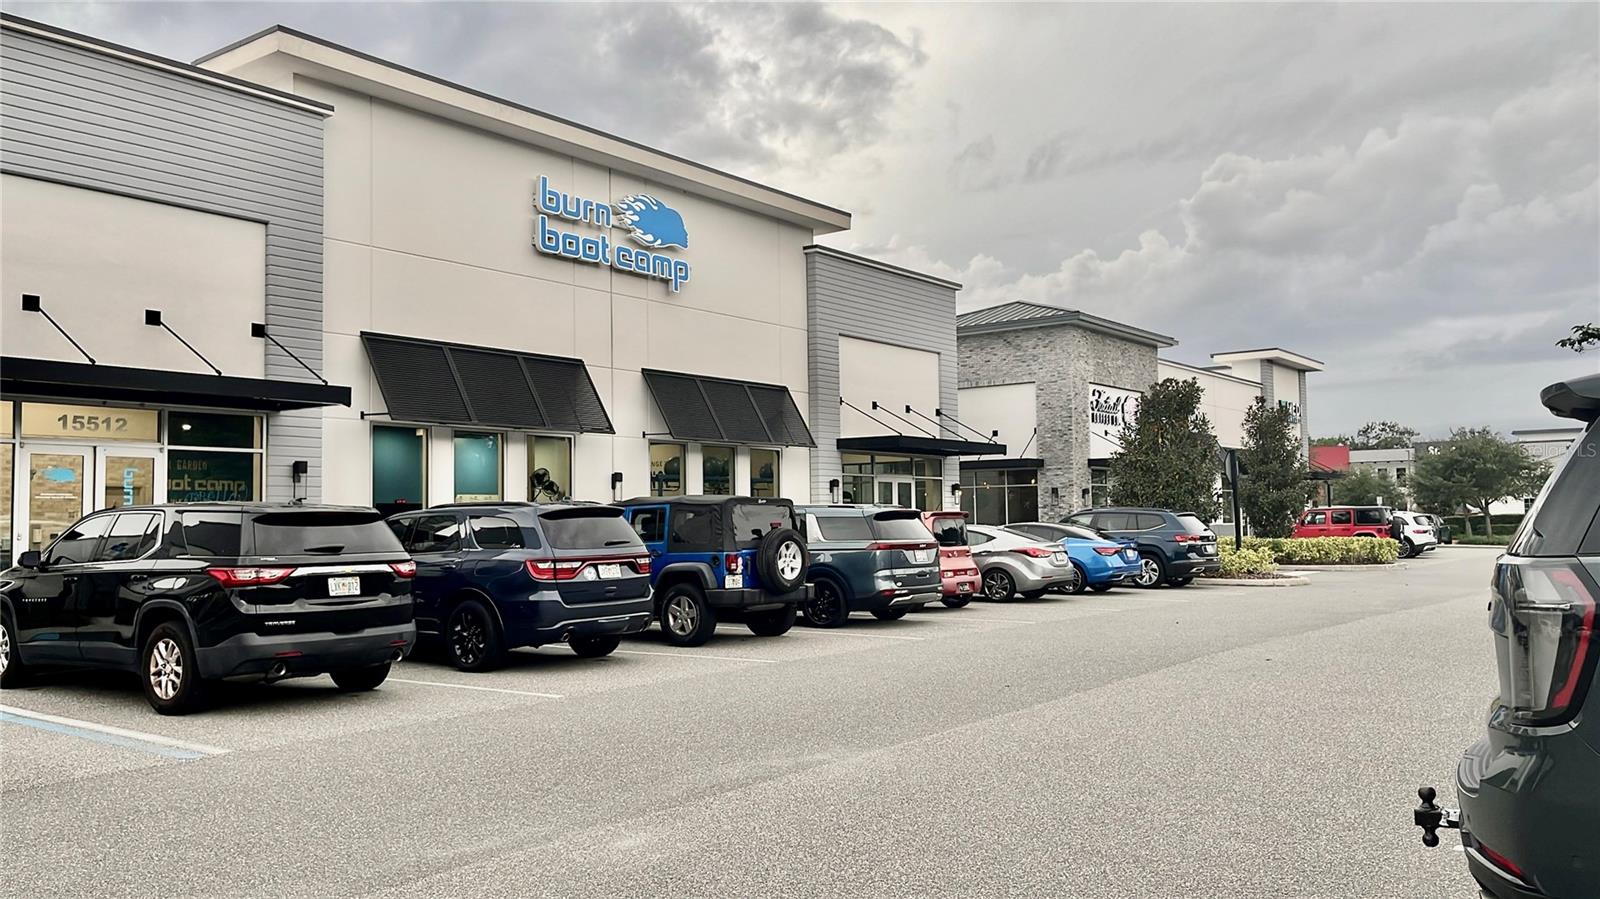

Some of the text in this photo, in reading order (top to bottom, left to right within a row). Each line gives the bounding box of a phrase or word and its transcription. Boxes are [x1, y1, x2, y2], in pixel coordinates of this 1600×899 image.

[539, 175, 612, 228] burn
[538, 214, 690, 293] boot camp
[57, 413, 128, 433] 15512
[123, 467, 139, 507] burn
[194, 480, 246, 498] camp
